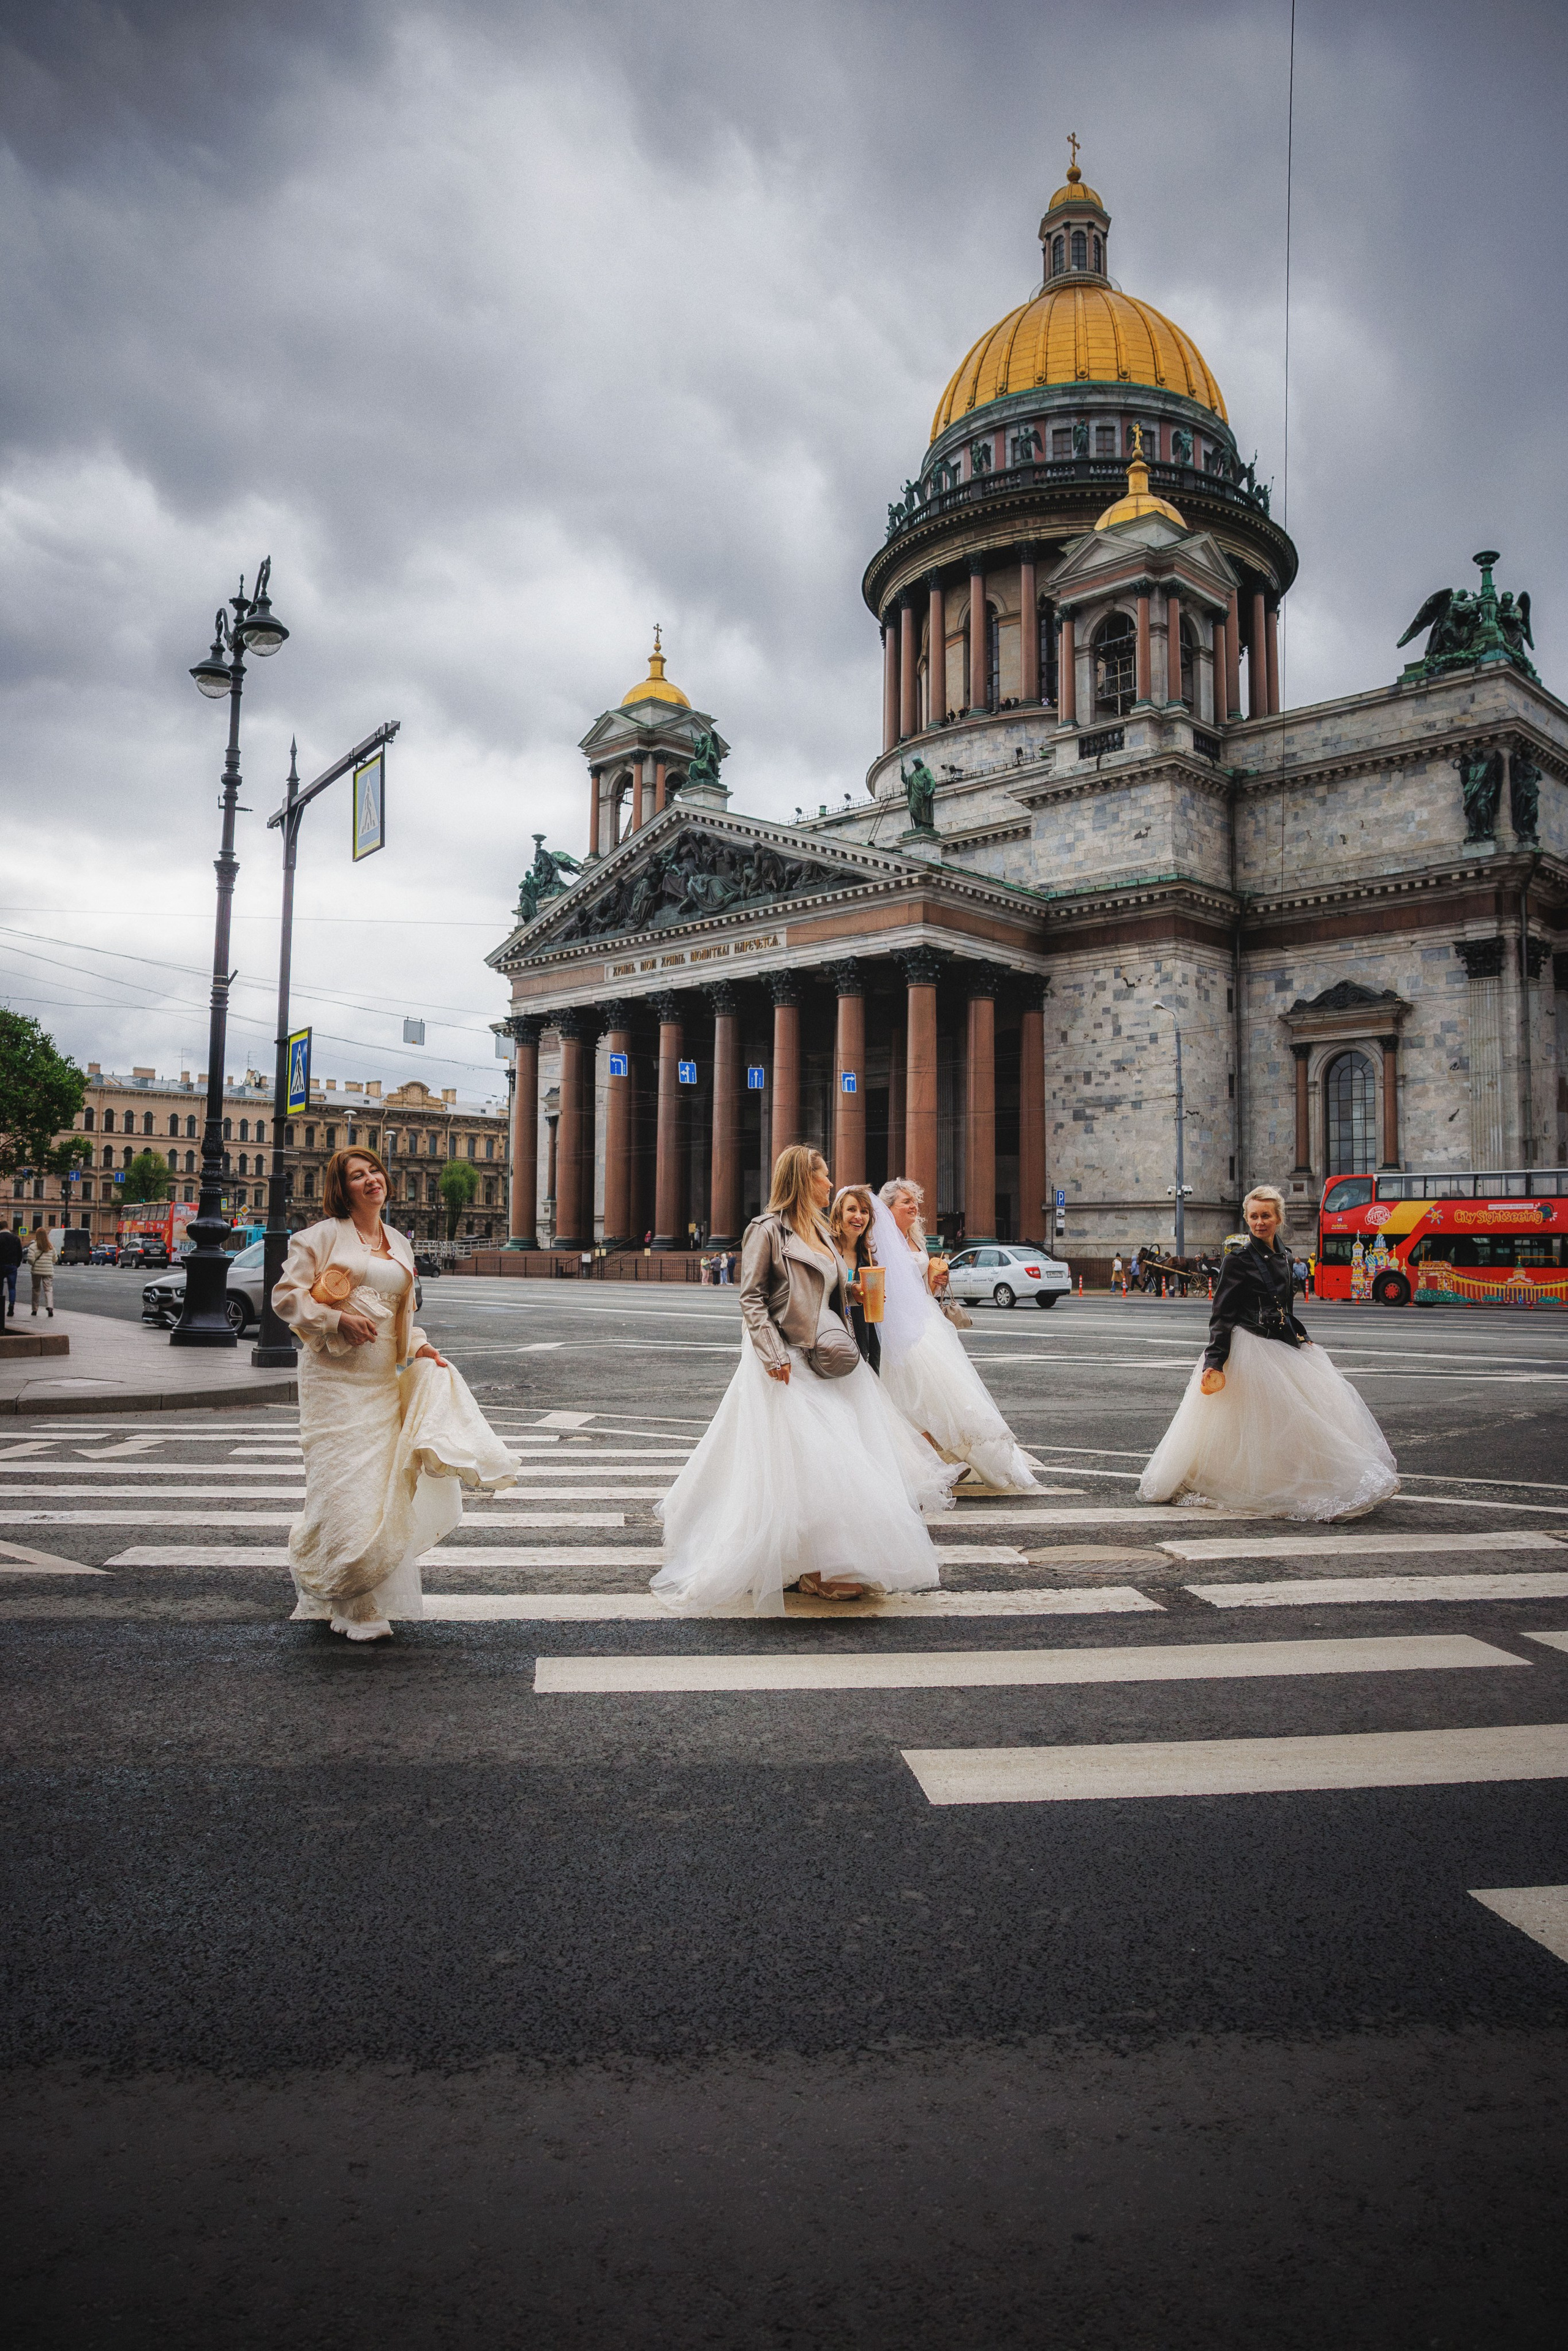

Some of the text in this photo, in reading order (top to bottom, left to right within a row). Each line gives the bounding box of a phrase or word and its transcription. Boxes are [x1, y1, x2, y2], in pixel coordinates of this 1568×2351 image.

[1058, 1191, 1064, 1205] P
[1366, 1212, 1390, 1223] OFFICIAL
[1455, 1209, 1543, 1225] City Sightseeing
